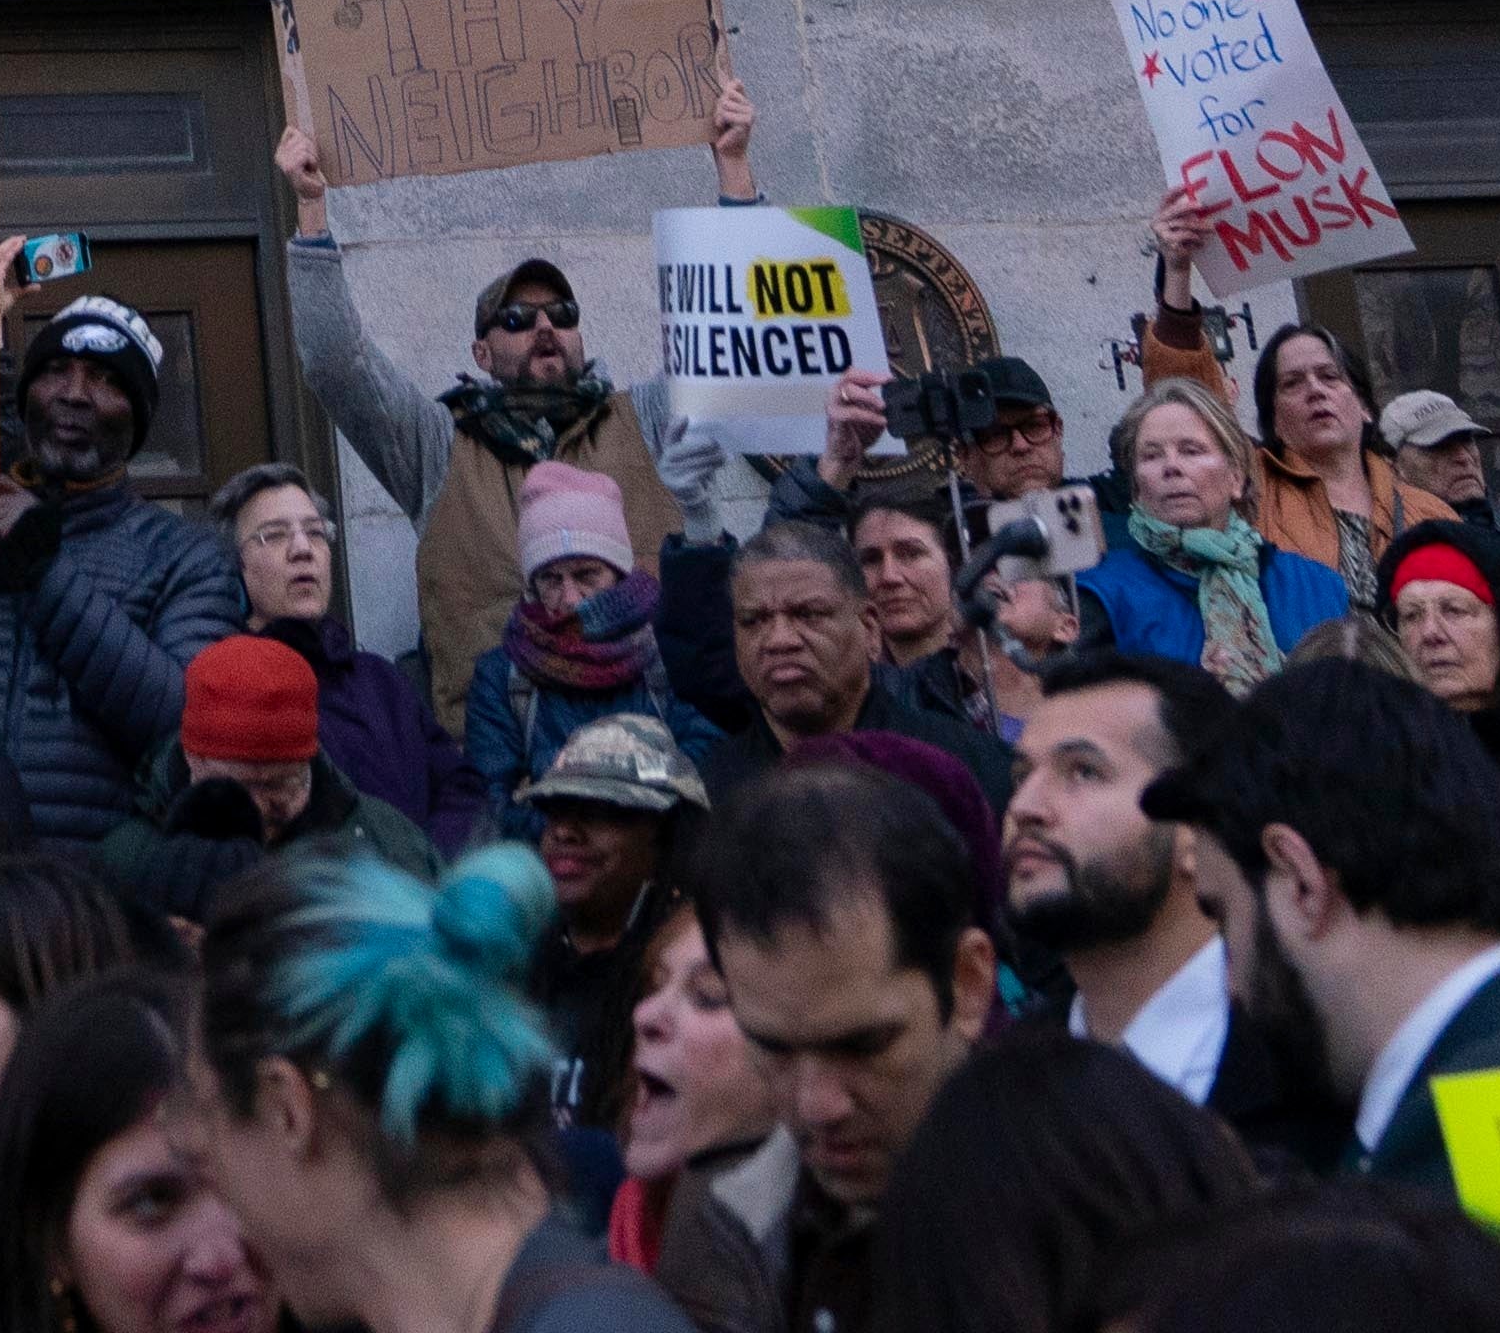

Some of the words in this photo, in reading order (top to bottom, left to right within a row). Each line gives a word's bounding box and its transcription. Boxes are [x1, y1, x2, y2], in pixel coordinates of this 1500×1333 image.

[1163, 11, 1284, 88] voted
[326, 20, 725, 181] NEIGHBOR
[1200, 94, 1267, 143] for
[1180, 106, 1346, 220] ELON
[1214, 166, 1400, 273] MUSK
[676, 263, 744, 314] WILL
[753, 262, 837, 316] NOT
[673, 323, 853, 377] SILENCED
